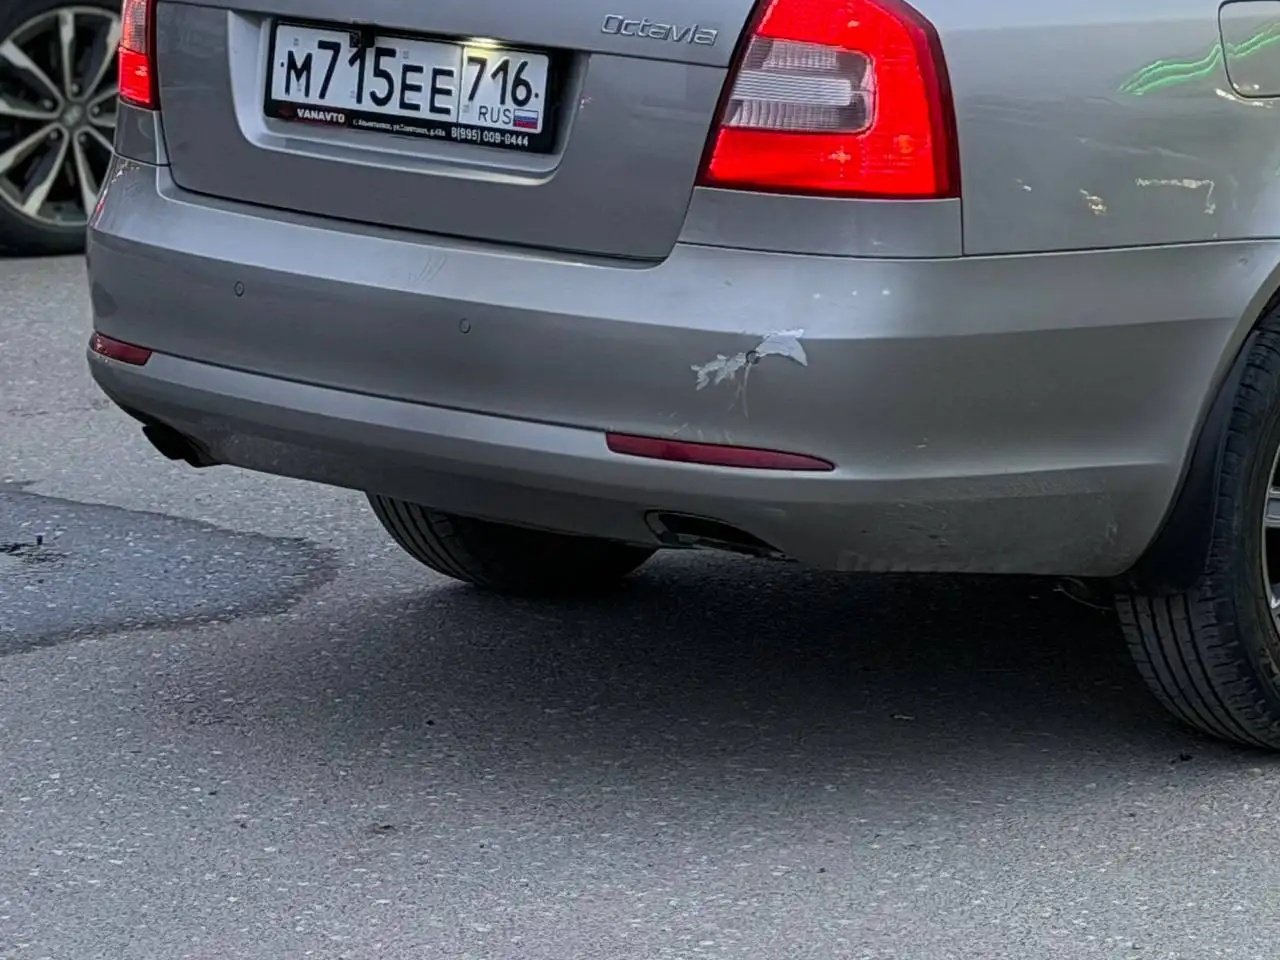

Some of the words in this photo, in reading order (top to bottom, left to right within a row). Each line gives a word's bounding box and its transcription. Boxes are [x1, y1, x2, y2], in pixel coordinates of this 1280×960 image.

[601, 13, 719, 46] Octavia
[466, 55, 534, 108] 716
[297, 108, 346, 124] VANAVTO
[478, 105, 513, 125] RUS
